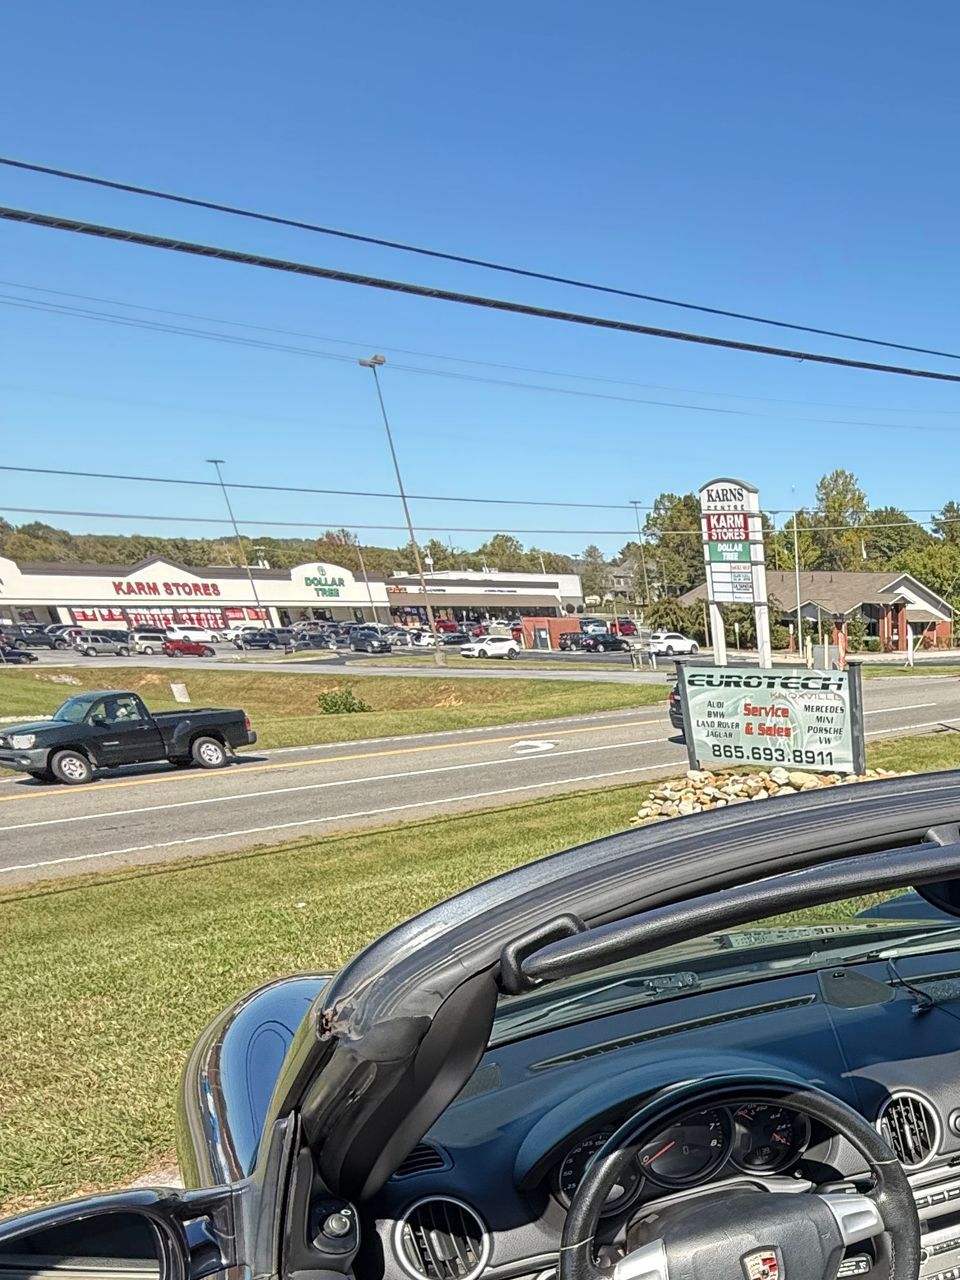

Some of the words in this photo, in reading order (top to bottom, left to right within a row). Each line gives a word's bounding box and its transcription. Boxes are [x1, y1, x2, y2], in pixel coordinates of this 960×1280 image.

[706, 488, 744, 502] KARNS
[710, 514, 744, 528] KARM
[712, 529, 745, 540] STORES
[717, 543, 742, 552] DOLLAR
[304, 577, 345, 587] DOLLAR
[112, 581, 160, 596] KARM
[162, 582, 220, 596] STORES
[314, 588, 340, 597] TREE
[687, 674, 844, 690] EUROTECH
[769, 692, 842, 701] KNOXVILLE
[706, 700, 724, 709] AUDI
[804, 704, 845, 714] MERCEDES
[707, 710, 725, 719] BMW
[744, 703, 789, 718] Service
[815, 715, 834, 724] MINI
[696, 720, 715, 728] LAND
[717, 720, 740, 730] ROVER
[745, 722, 754, 736] &
[758, 723, 792, 738] Sales
[705, 730, 733, 739] JAGUAR
[807, 726, 844, 735] PORSCHE
[818, 736, 832, 745] VW
[712, 744, 833, 766] 865.693.8911
